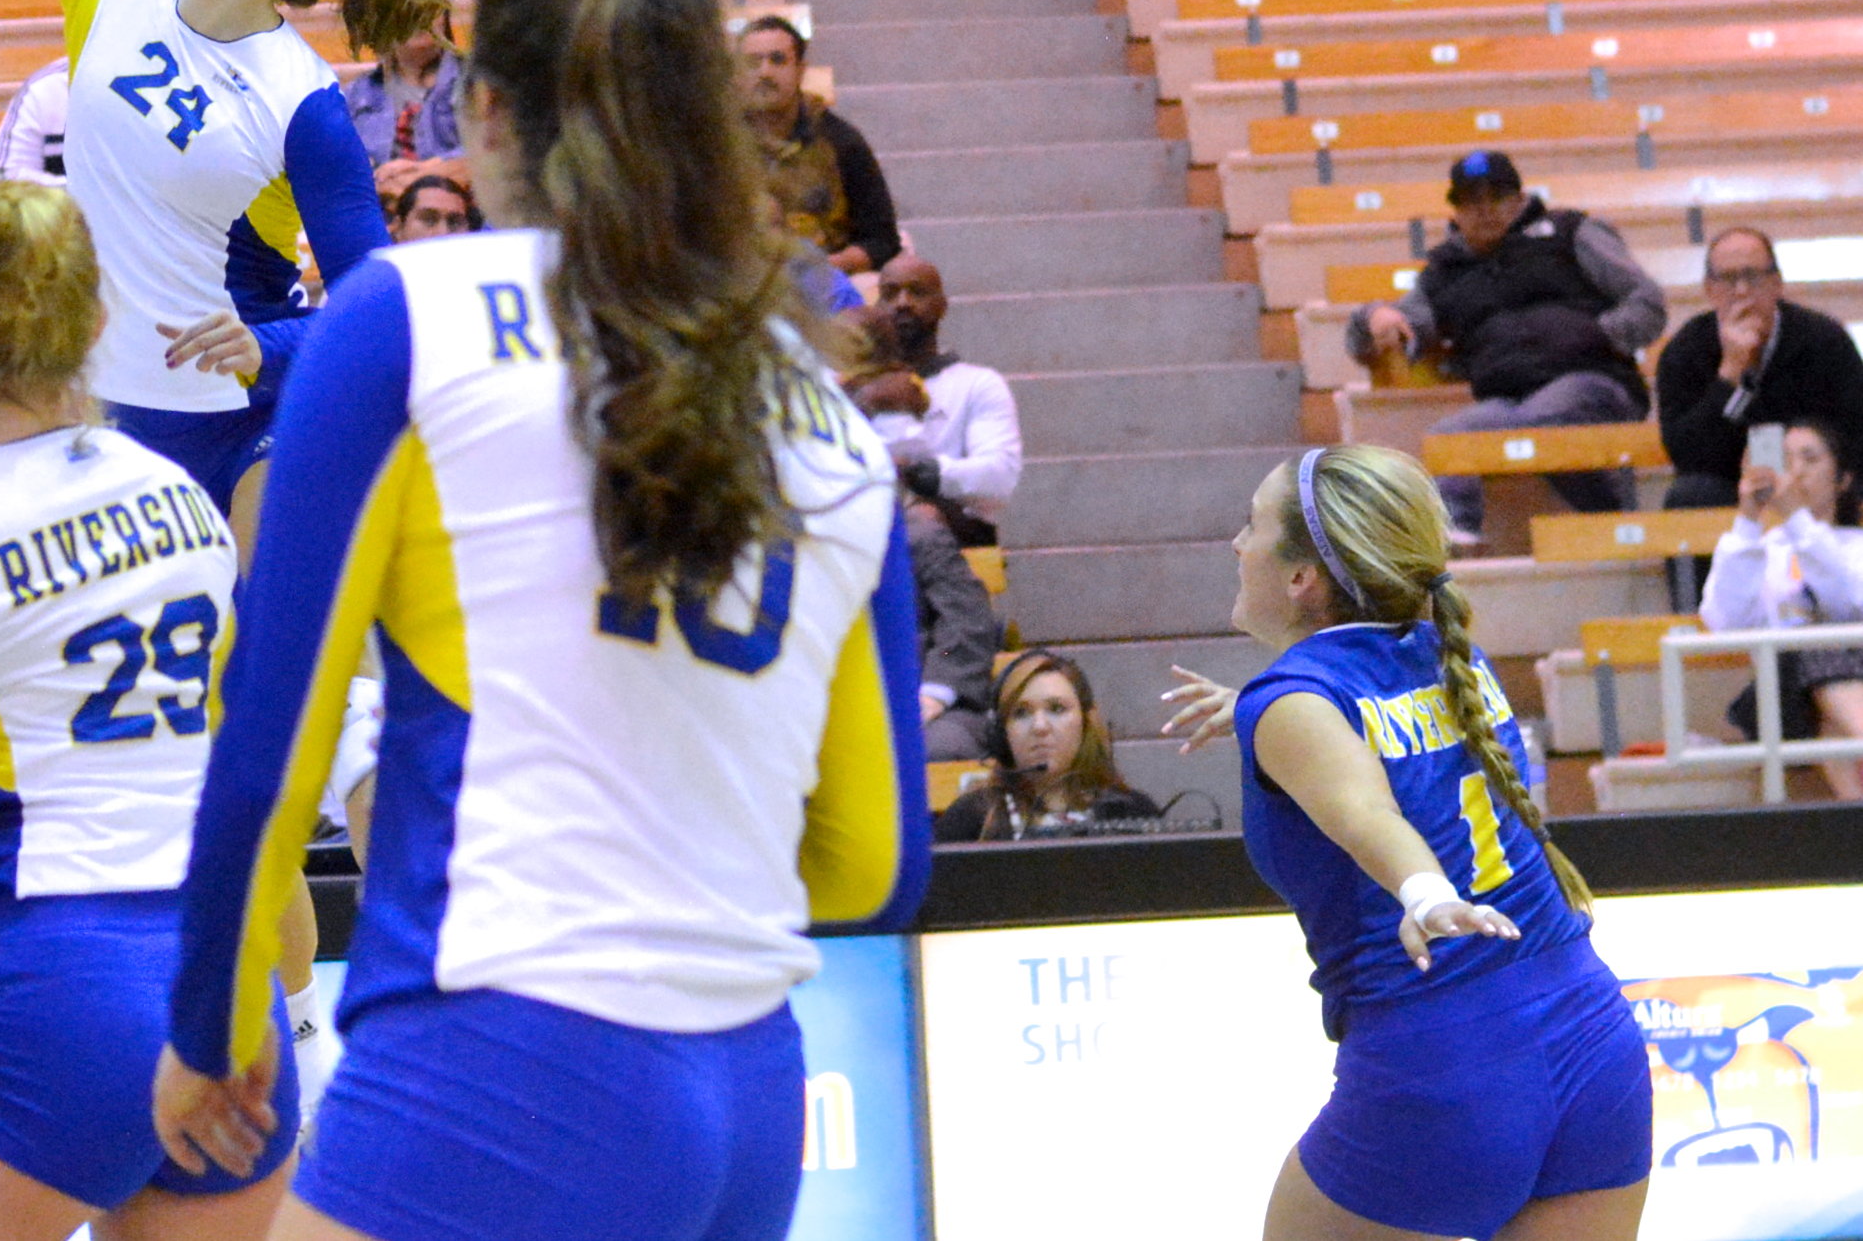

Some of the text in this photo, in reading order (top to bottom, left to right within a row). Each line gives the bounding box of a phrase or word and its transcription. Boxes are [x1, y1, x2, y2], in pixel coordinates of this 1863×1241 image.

[109, 41, 214, 154] 24
[596, 540, 797, 676] 0
[62, 591, 220, 746] 29
[1355, 658, 1515, 759] RIVER
[1459, 770, 1515, 896] 1
[1018, 954, 1126, 1006] THE
